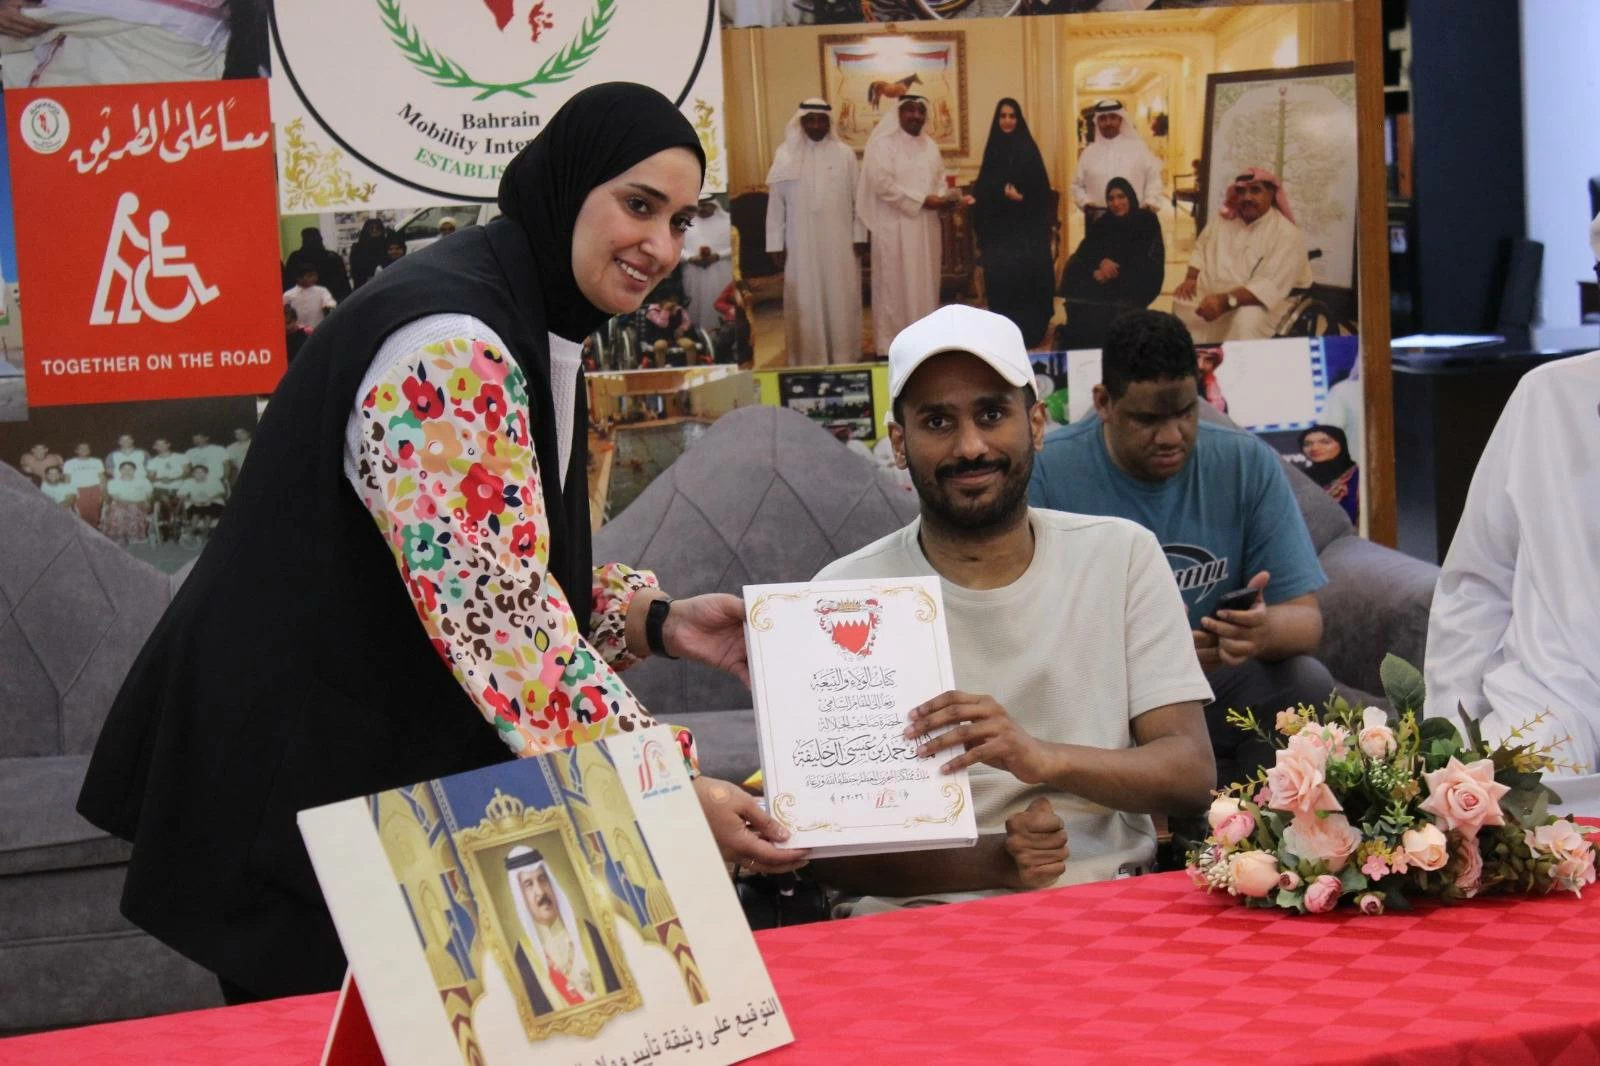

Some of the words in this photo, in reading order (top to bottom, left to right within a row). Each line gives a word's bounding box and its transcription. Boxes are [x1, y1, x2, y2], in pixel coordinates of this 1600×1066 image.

[397, 102, 478, 156] Mobility
[461, 111, 540, 130] Bahrain
[67, 102, 172, 175] الطريق
[41, 356, 140, 376] TOGETHER
[146, 354, 172, 371] ON
[178, 352, 214, 369] THE
[220, 348, 272, 364] ROAD
[709, 1015, 730, 1045] على
[735, 996, 779, 1037] التوقيع
[663, 1024, 704, 1054] وثيقة
